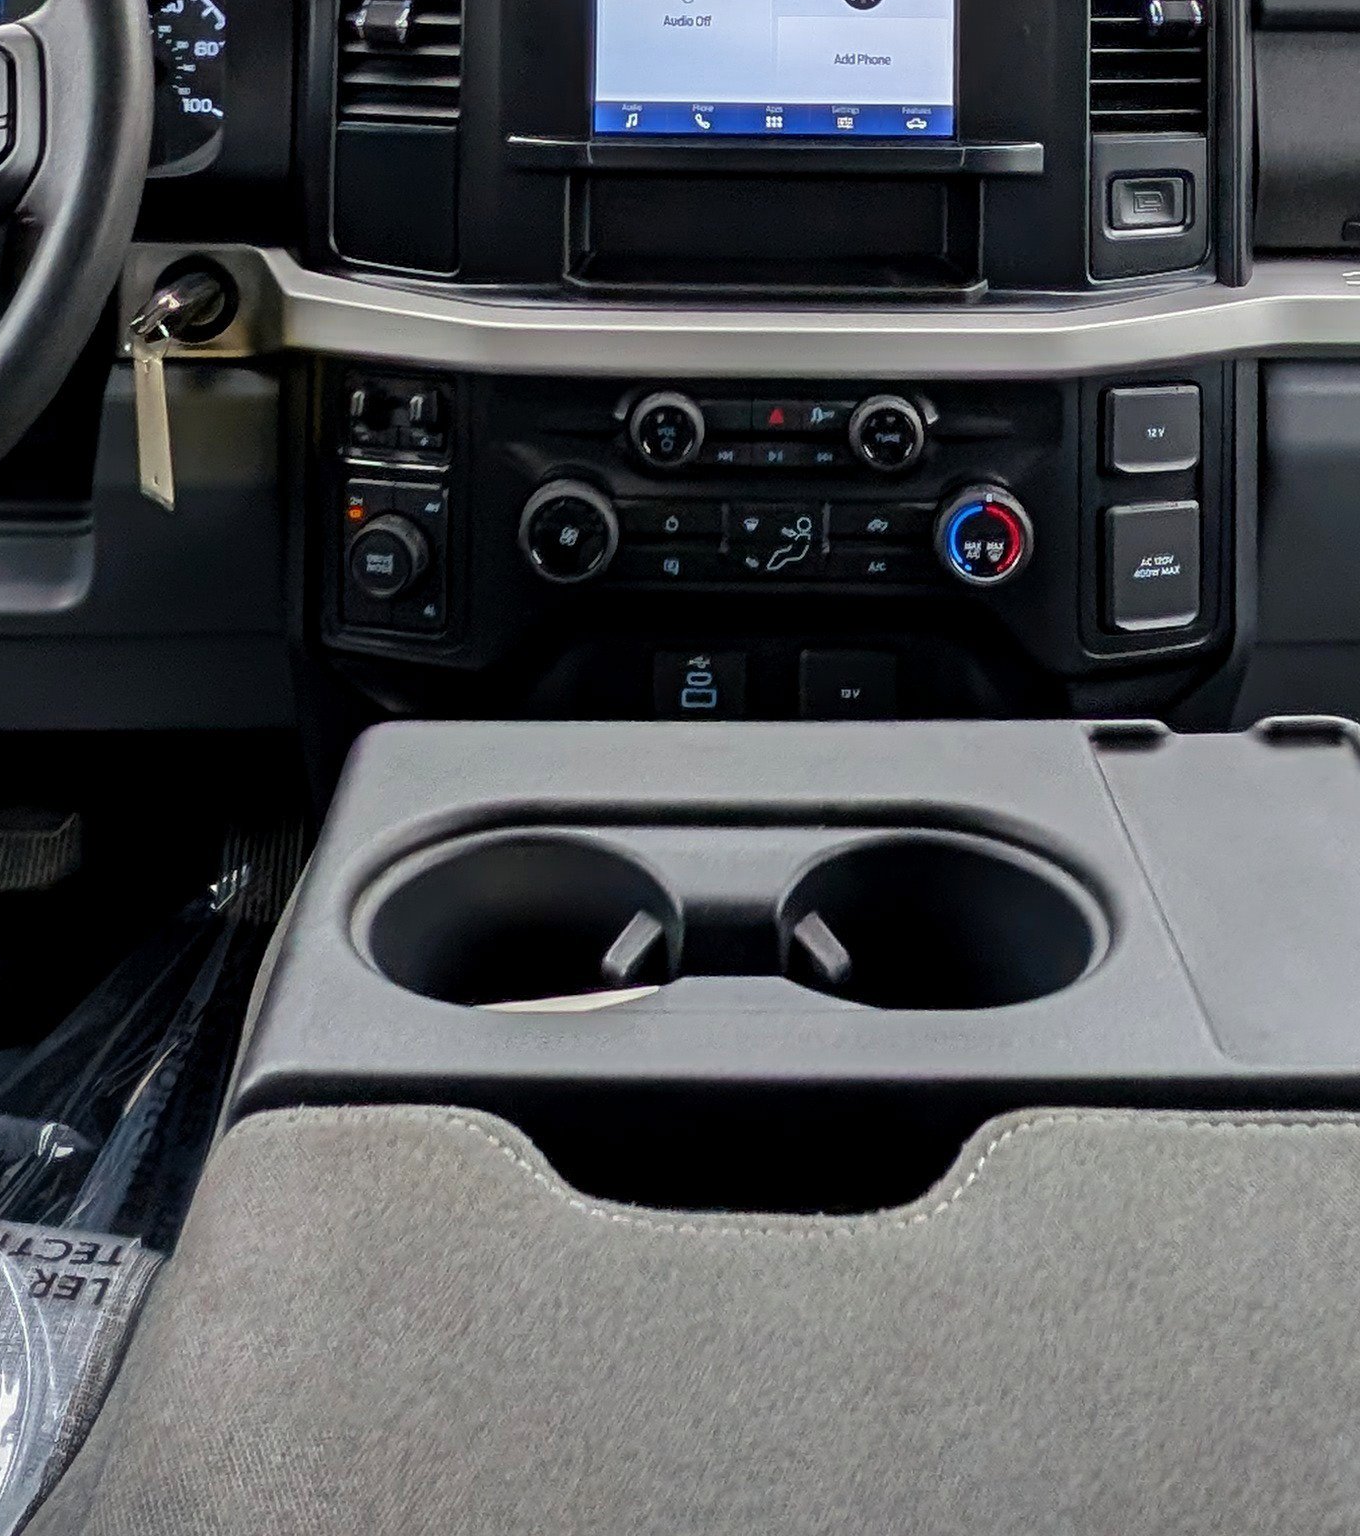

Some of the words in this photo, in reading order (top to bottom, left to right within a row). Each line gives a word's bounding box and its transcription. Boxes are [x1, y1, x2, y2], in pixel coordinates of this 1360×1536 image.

[663, 14, 693, 27] Audio
[696, 14, 712, 27] Off
[834, 53, 855, 66] Add
[857, 53, 891, 66] Phone
[182, 97, 213, 113] 100
[1161, 564, 1181, 577] MAX
[28, 1267, 112, 1306] LER
